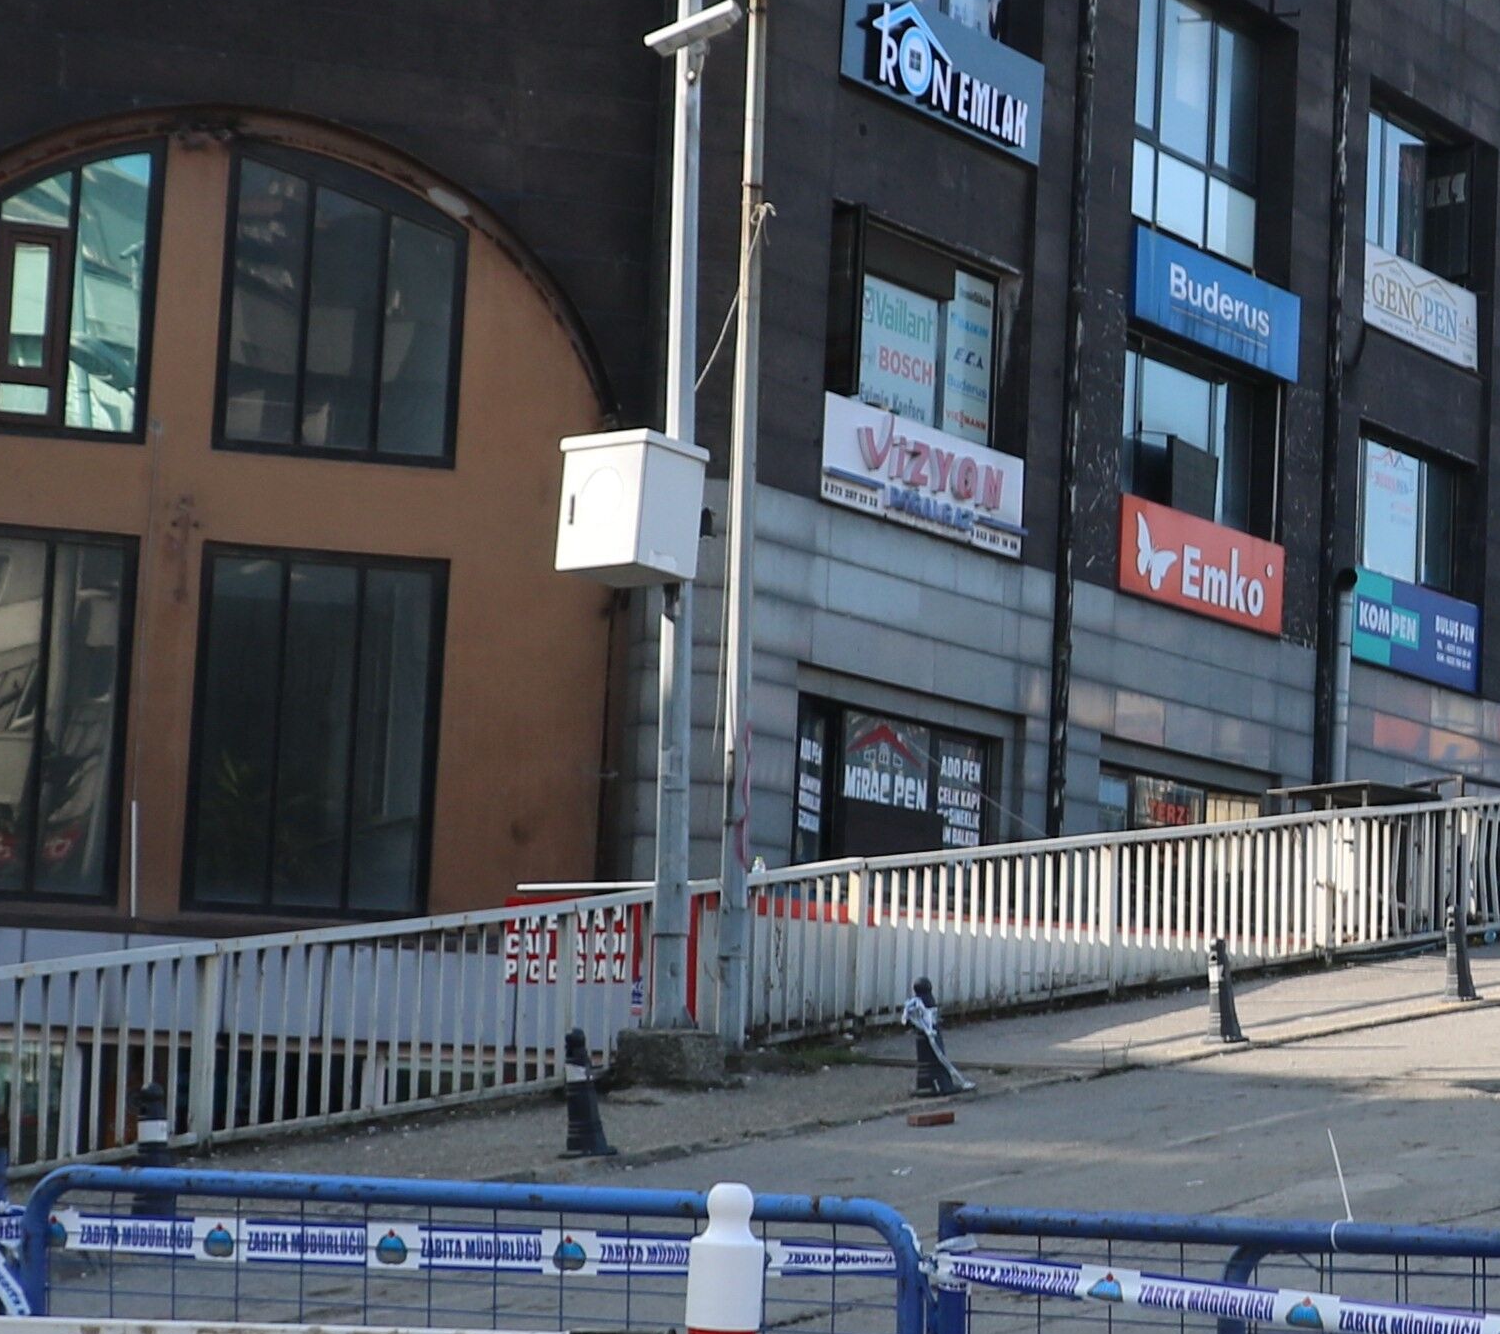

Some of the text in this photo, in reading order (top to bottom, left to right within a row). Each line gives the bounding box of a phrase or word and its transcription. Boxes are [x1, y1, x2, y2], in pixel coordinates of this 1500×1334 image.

[958, 71, 1028, 148] EMLAK
[875, 290, 932, 343] Vaillant
[1170, 262, 1269, 337] Buderus
[1372, 273, 1457, 343] GENÇPEN
[879, 345, 932, 386] BOSCH
[1182, 544, 1264, 617] Emko
[894, 774, 927, 810] PEN
[79, 1223, 193, 1249] ZABITA MÜDÜRLÜĞÜ
[247, 1229, 364, 1255] ZABITA MÜDÜRLÜĞÜ
[421, 1236, 541, 1261] ZABITA MÜDÜRLÜĞÜ
[600, 1244, 644, 1264] ZABITA
[1139, 1282, 1274, 1322] ZABITA MÜDÜRLÜĞÜ
